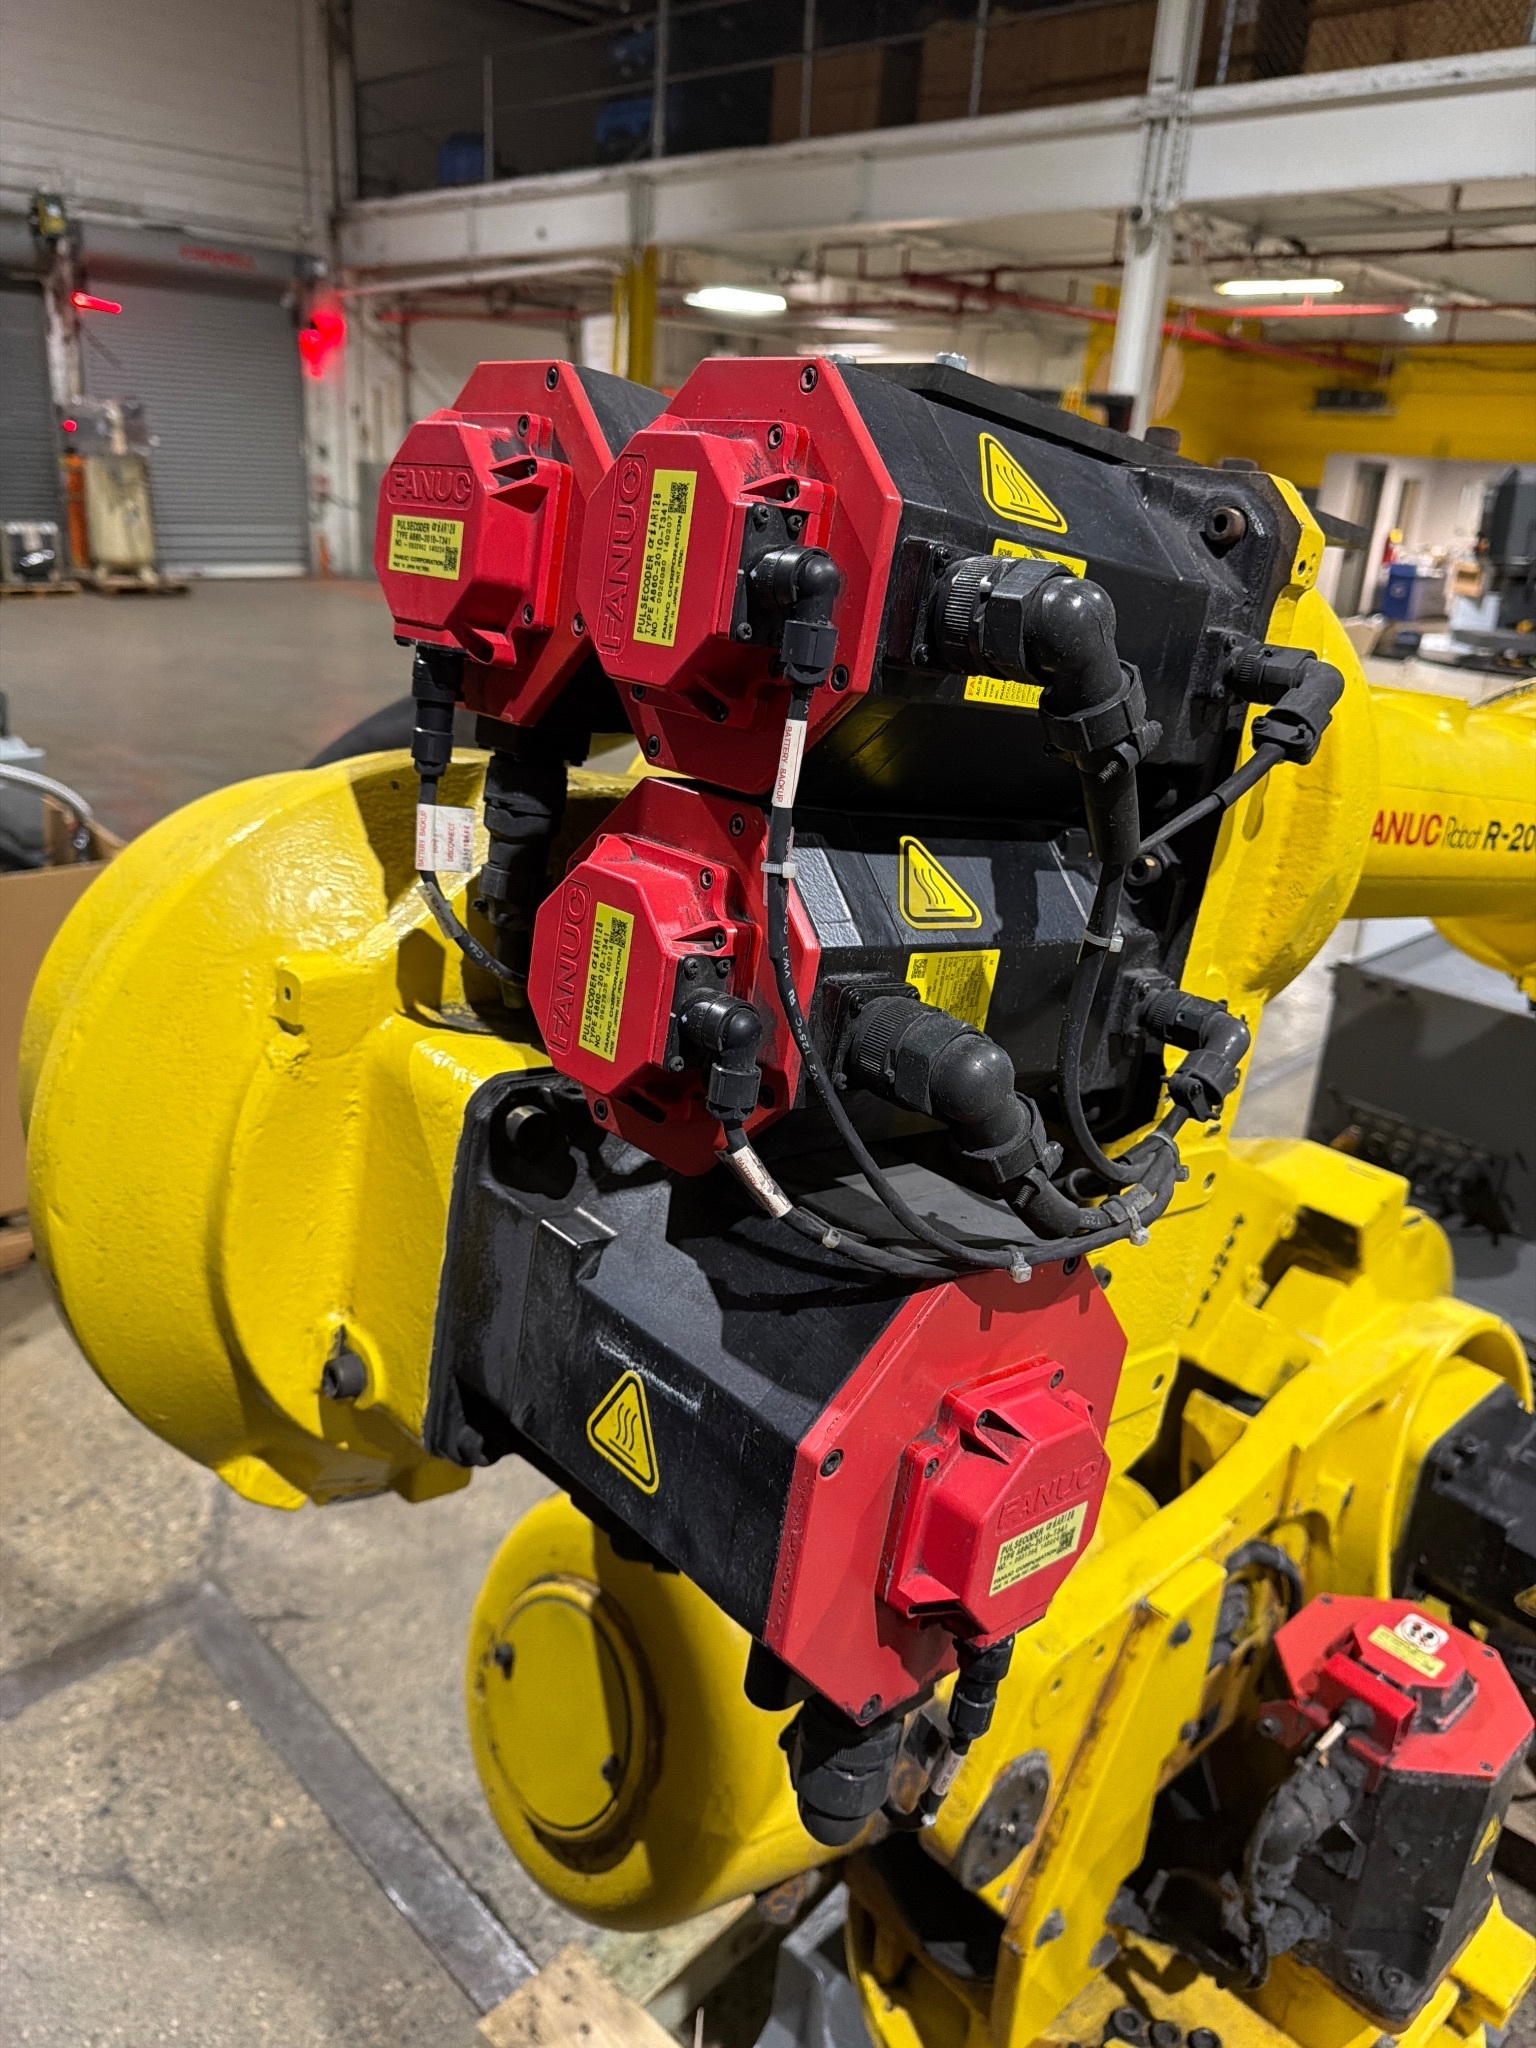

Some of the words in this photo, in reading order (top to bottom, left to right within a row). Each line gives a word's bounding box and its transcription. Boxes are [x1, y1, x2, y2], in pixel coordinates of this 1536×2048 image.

[390, 468, 471, 504] FANUC
[395, 530, 408, 539] TYPE
[396, 519, 430, 532] PULSECODER
[600, 462, 642, 650] FANUC
[644, 606, 653, 634] TYPE
[649, 502, 668, 602] A860-2010-T341
[636, 554, 654, 633] PULSECODER
[661, 601, 671, 639] FANUC
[667, 515, 682, 597] CORPORATION
[784, 726, 792, 763] BATTERY
[776, 768, 787, 802] BACKUP
[418, 840, 426, 867] BATTERY
[447, 822, 456, 862] DISCONNECT
[1482, 821, 1536, 852] R-20
[468, 941, 484, 958] CSA
[549, 888, 586, 1050] FANUC
[588, 1019, 596, 1045] TYPE
[592, 931, 609, 1018] A860-2010-T341
[603, 1020, 612, 1053] FANUC
[608, 947, 622, 1018] CORPORATION
[581, 973, 597, 1042] PULSECODER
[736, 1157, 759, 1186] BATTERY
[998, 1461, 1098, 1530] FANUC
[999, 1549, 1014, 1564] TYPE
[1000, 1526, 1043, 1556] PULSECODER
[993, 1569, 1014, 1584] FANUC
[1014, 1547, 1056, 1573] CORPORATION
